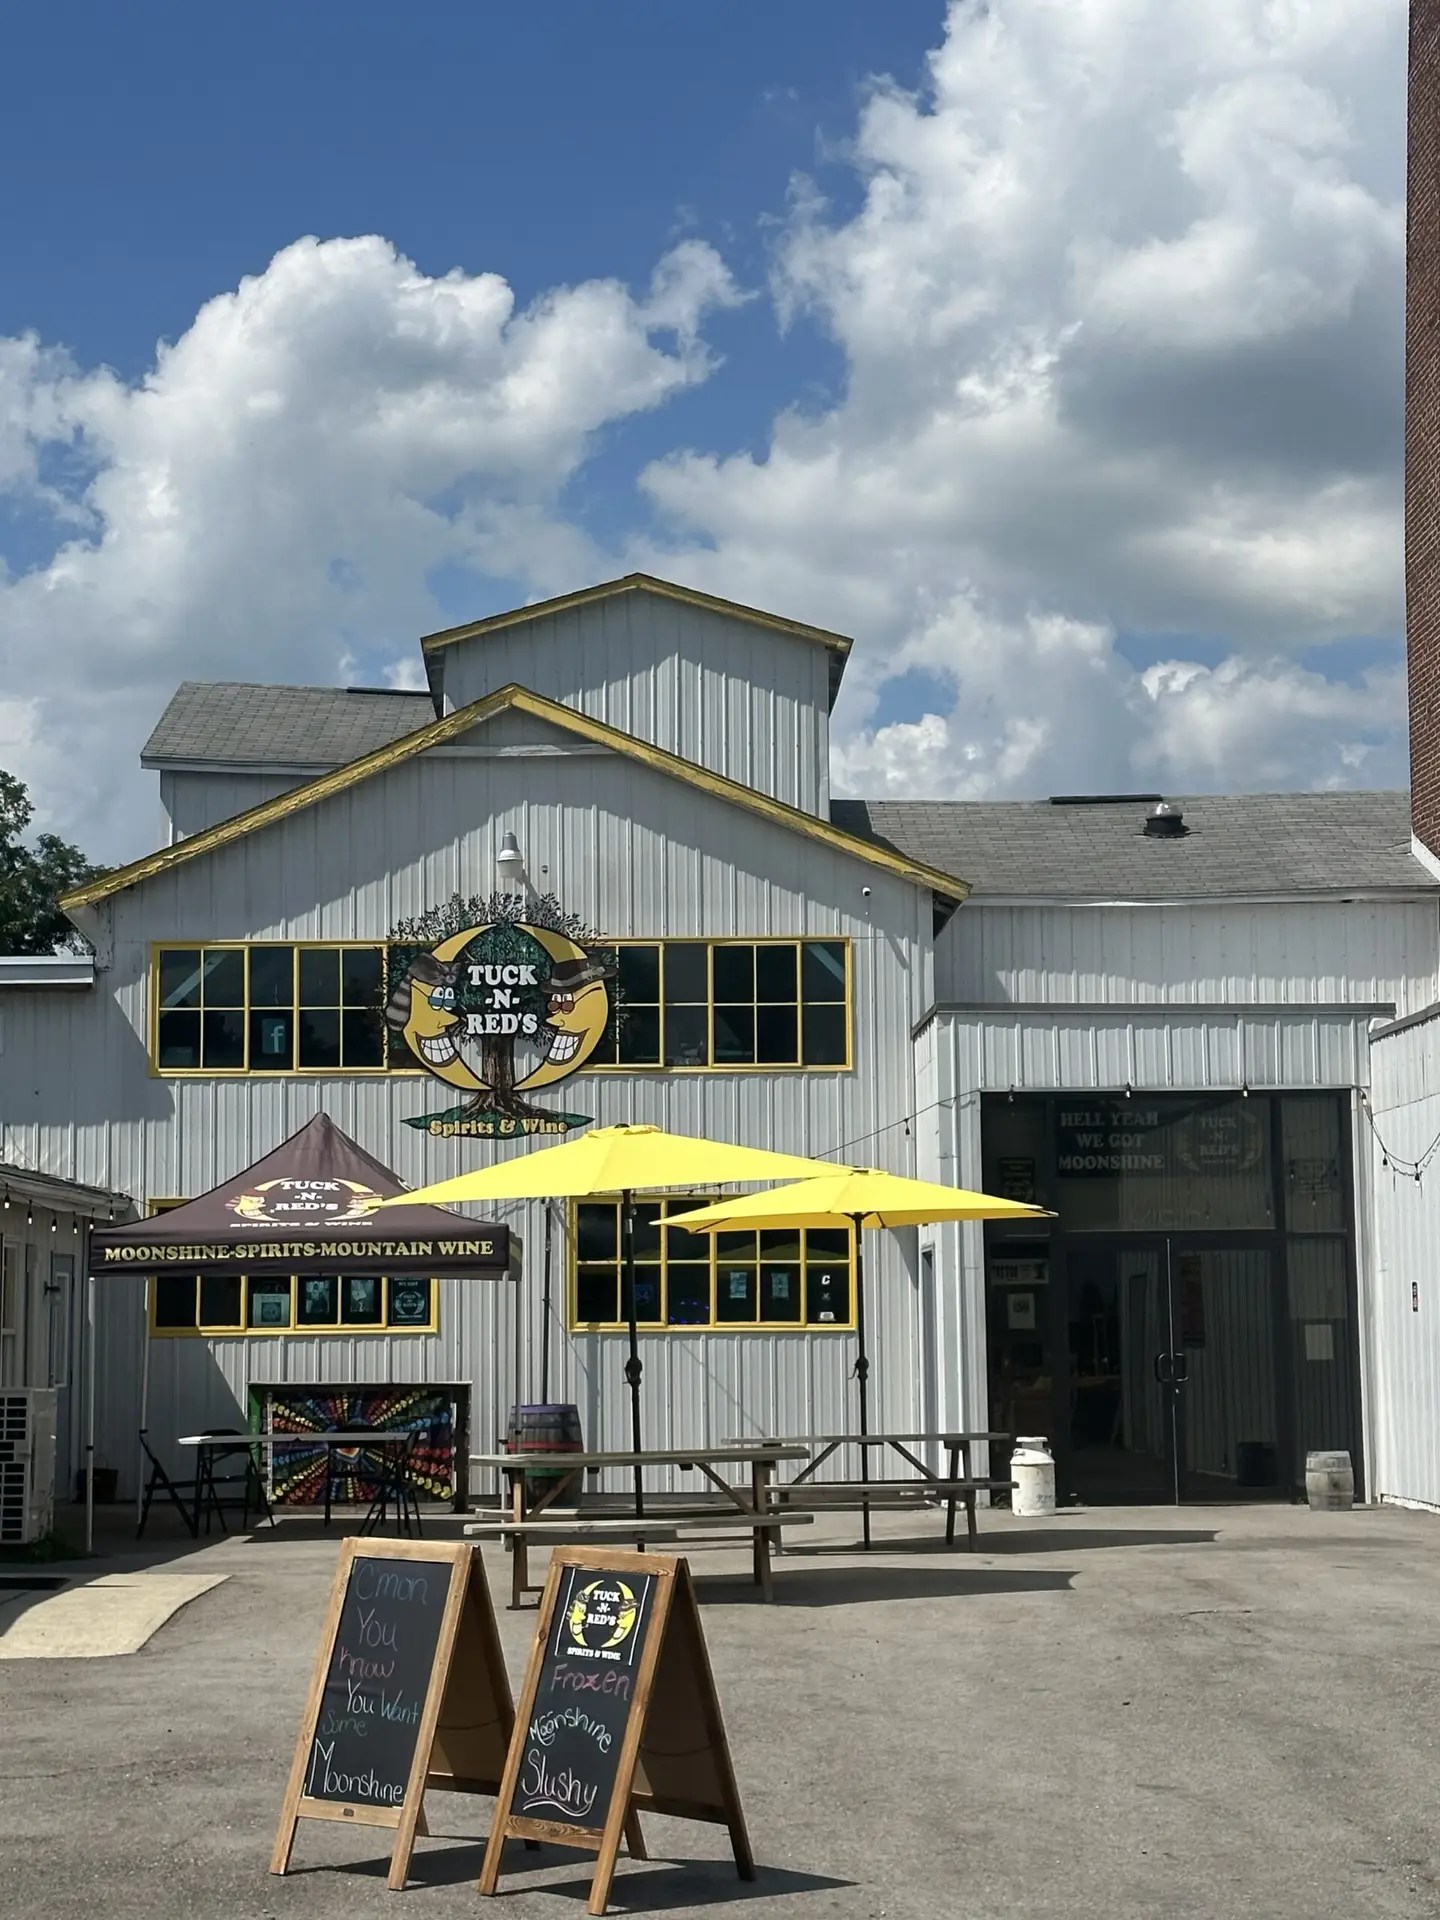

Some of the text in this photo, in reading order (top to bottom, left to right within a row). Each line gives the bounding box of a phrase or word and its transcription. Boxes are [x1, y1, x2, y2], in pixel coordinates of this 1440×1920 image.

[467, 964, 538, 986] TUCK
[485, 989, 520, 1009] -N-
[466, 1013, 538, 1034] RED'S
[429, 1118, 568, 1138] Spirits & Wine
[1060, 1111, 1158, 1127] HELL YEAH
[1076, 1133, 1145, 1148] WE GOT
[1058, 1154, 1165, 1170] MOONSHINE
[280, 1181, 340, 1191] TUCK
[275, 1202, 338, 1211] RED'S
[294, 1192, 322, 1201] -N-
[437, 1240, 493, 1256] WINE
[593, 1590, 621, 1602] TUCK
[357, 1606, 398, 1652] You
[587, 1613, 617, 1626] RED'S
[567, 1647, 593, 1657] SPIRITS
[551, 1663, 630, 1700] Frozen
[347, 1678, 419, 1724] You Want
[322, 1709, 368, 1737] Some
[529, 1707, 612, 1754] Moonshine
[309, 1738, 404, 1802] Moonshine
[521, 1749, 598, 1815] Slushy
